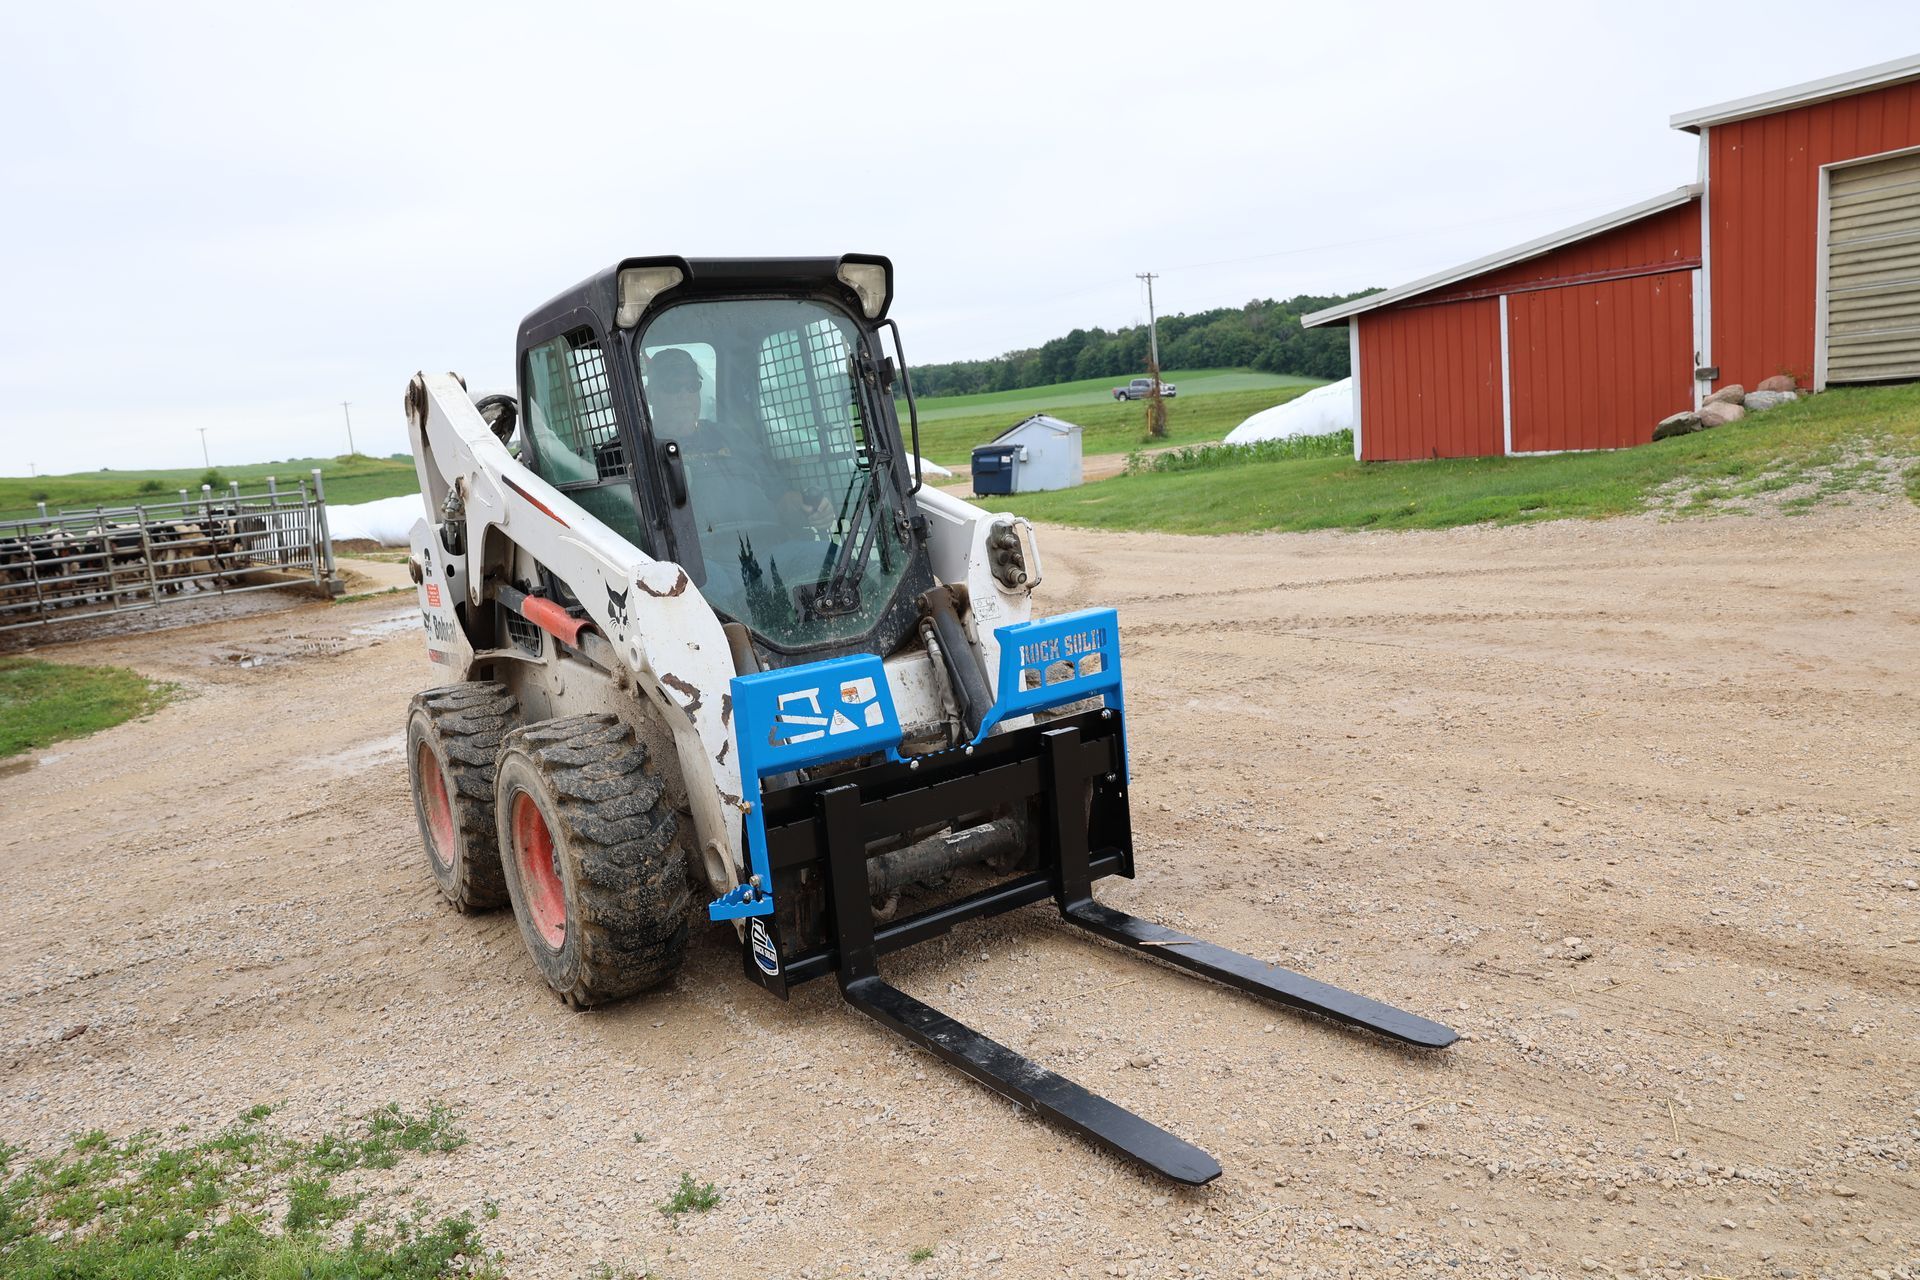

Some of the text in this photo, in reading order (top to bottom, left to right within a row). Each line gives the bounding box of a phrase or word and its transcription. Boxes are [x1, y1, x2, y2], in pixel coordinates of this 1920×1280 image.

[432, 615, 457, 644] Bobcat
[1019, 628, 1107, 667] ROCK SOLID
